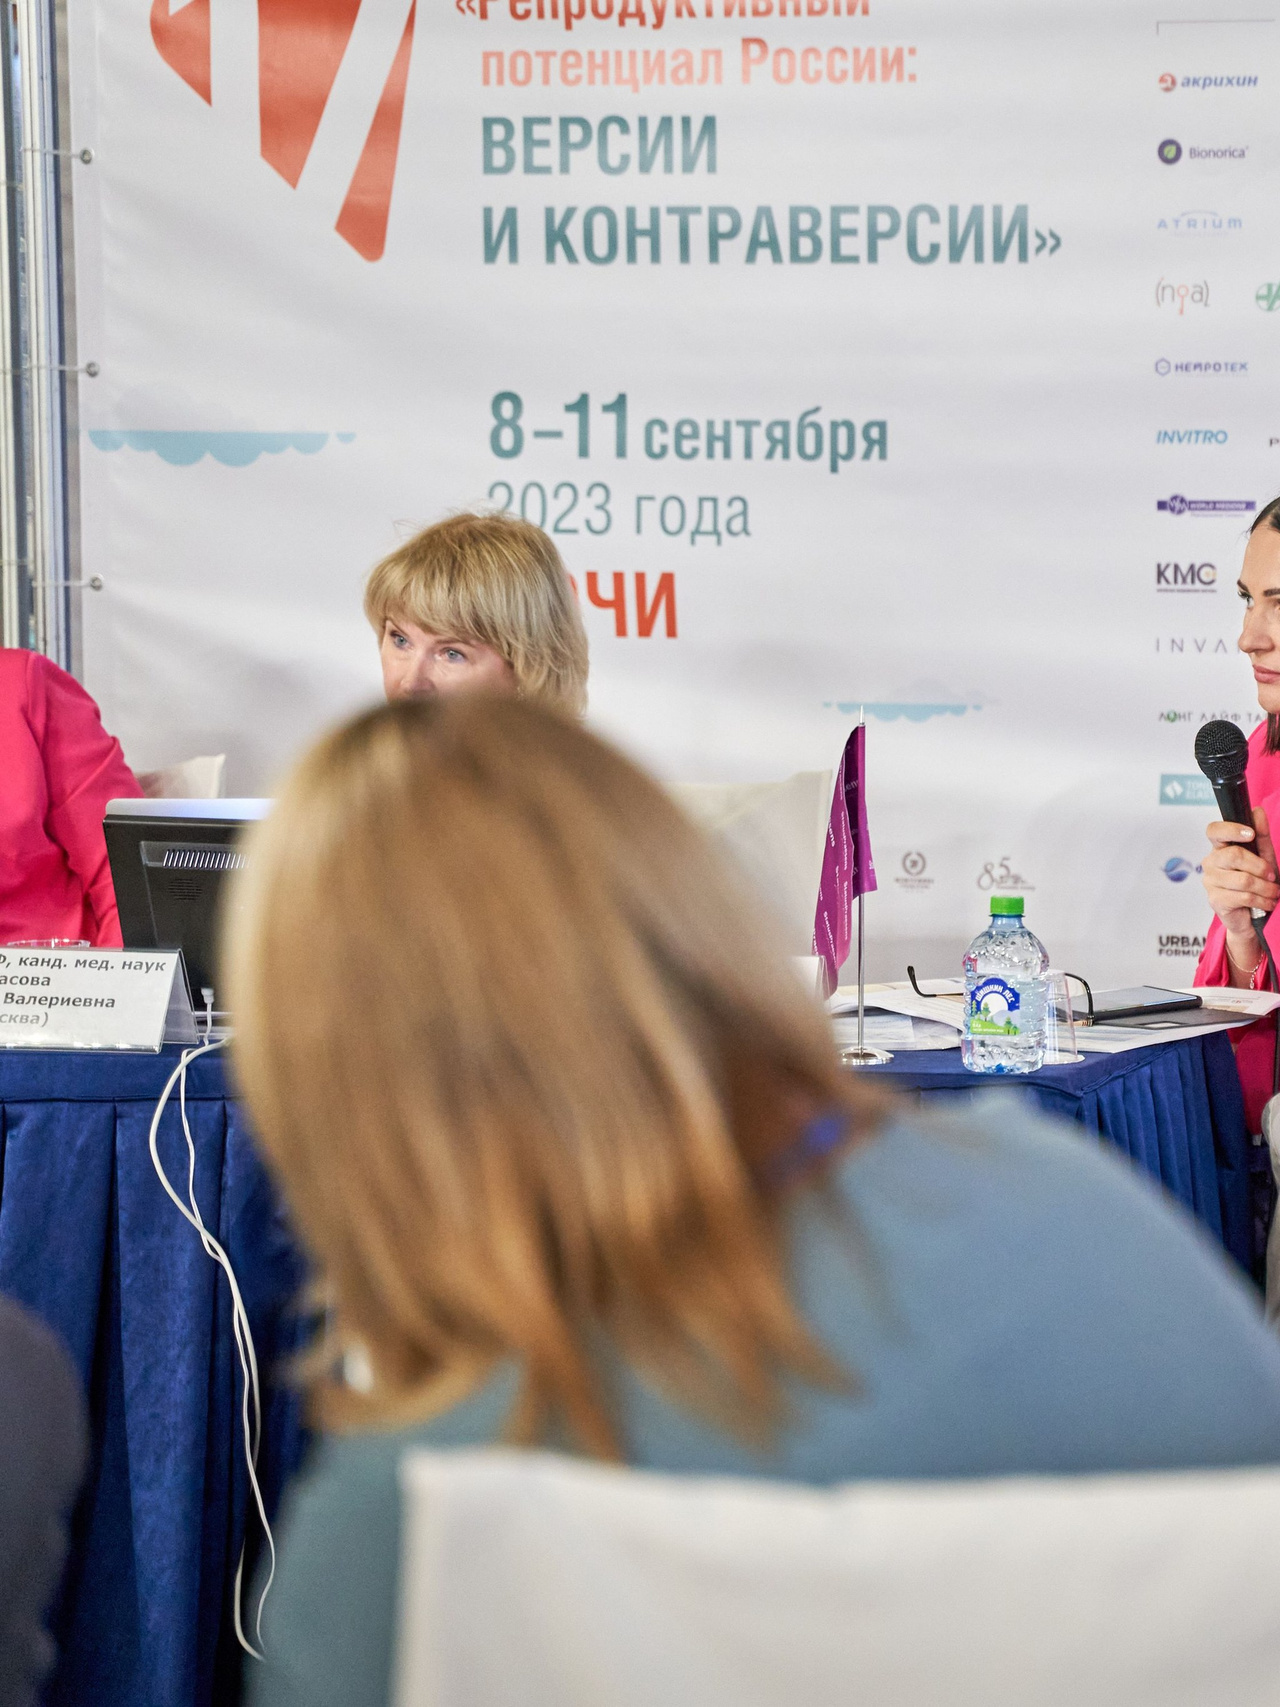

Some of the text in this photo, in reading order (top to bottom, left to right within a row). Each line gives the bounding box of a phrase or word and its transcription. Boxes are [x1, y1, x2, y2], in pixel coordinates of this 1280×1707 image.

[481, 37, 918, 94] потенциал России:
[1181, 75, 1258, 90] акрихин
[482, 115, 718, 176] ВЕРСИИ
[482, 204, 1063, 266] И КОНТРАВЕРСИИ»
[643, 406, 889, 474] сентября
[1157, 430, 1228, 444] INVITRO
[635, 495, 752, 547] года
[567, 571, 678, 639] ЧИ
[1155, 638, 1240, 654] INVA
[1158, 948, 1201, 958] FORMU
[18, 956, 67, 970] канд.
[74, 958, 115, 972] мед.
[121, 960, 166, 974] наук
[3, 992, 116, 1009] Валериевна
[1003, 989, 1015, 1003] ЛЕС
